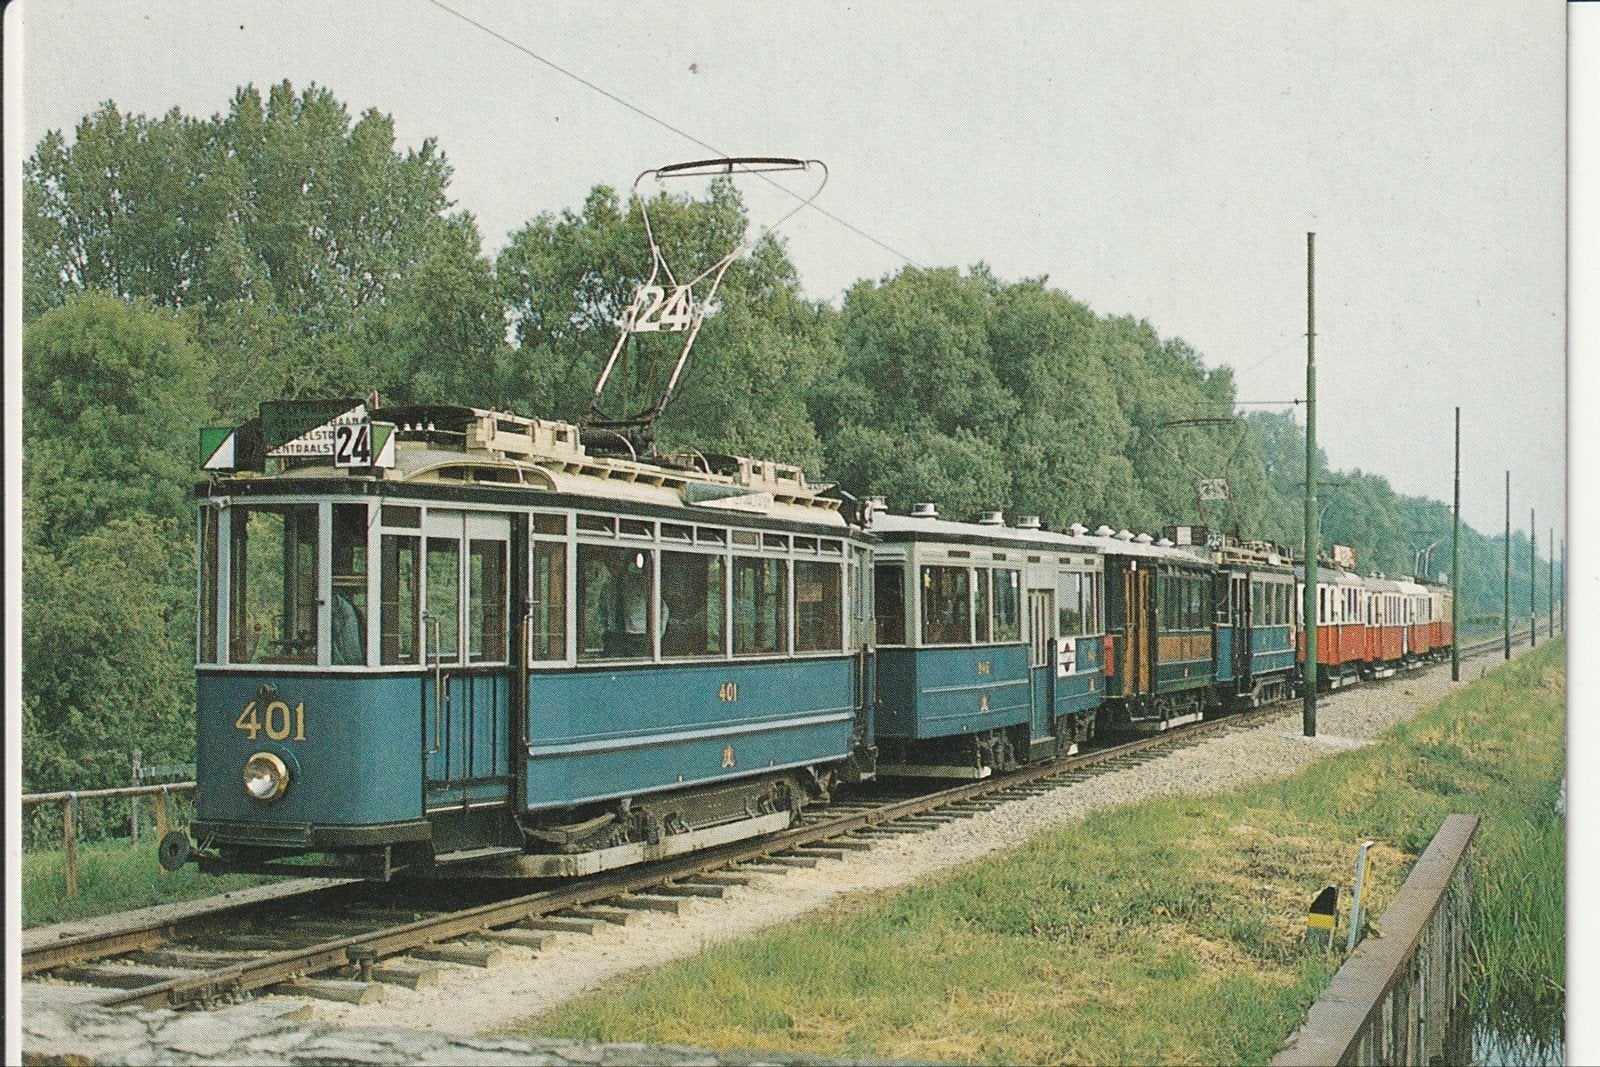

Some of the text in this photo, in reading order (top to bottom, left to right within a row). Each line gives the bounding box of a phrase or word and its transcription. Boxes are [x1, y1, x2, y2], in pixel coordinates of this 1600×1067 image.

[634, 285, 691, 332] 24
[337, 425, 371, 464] 24
[719, 682, 737, 702] 401
[234, 701, 307, 741] 401
